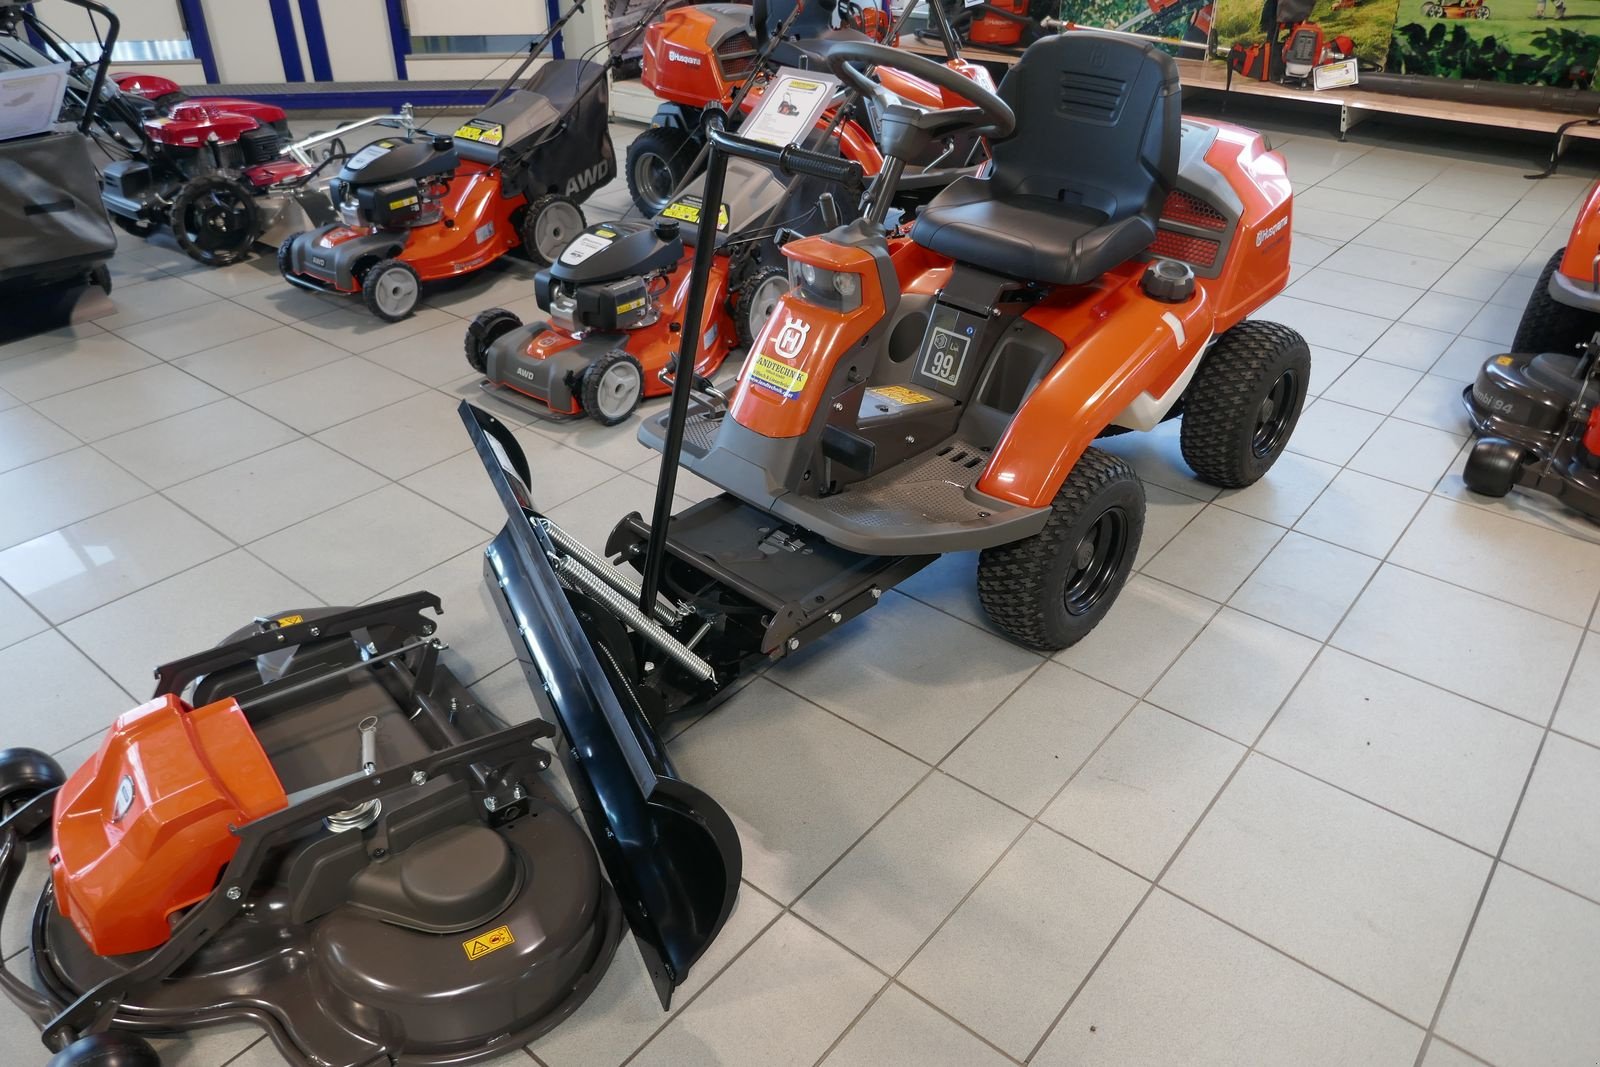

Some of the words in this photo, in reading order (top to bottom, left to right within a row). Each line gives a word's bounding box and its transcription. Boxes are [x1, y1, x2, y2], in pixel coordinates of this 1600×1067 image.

[565, 160, 608, 197] AWD
[516, 367, 535, 380] AWD
[755, 356, 804, 382] ANDTECHNK
[931, 351, 954, 378] 99
[1494, 398, 1514, 414] 94
